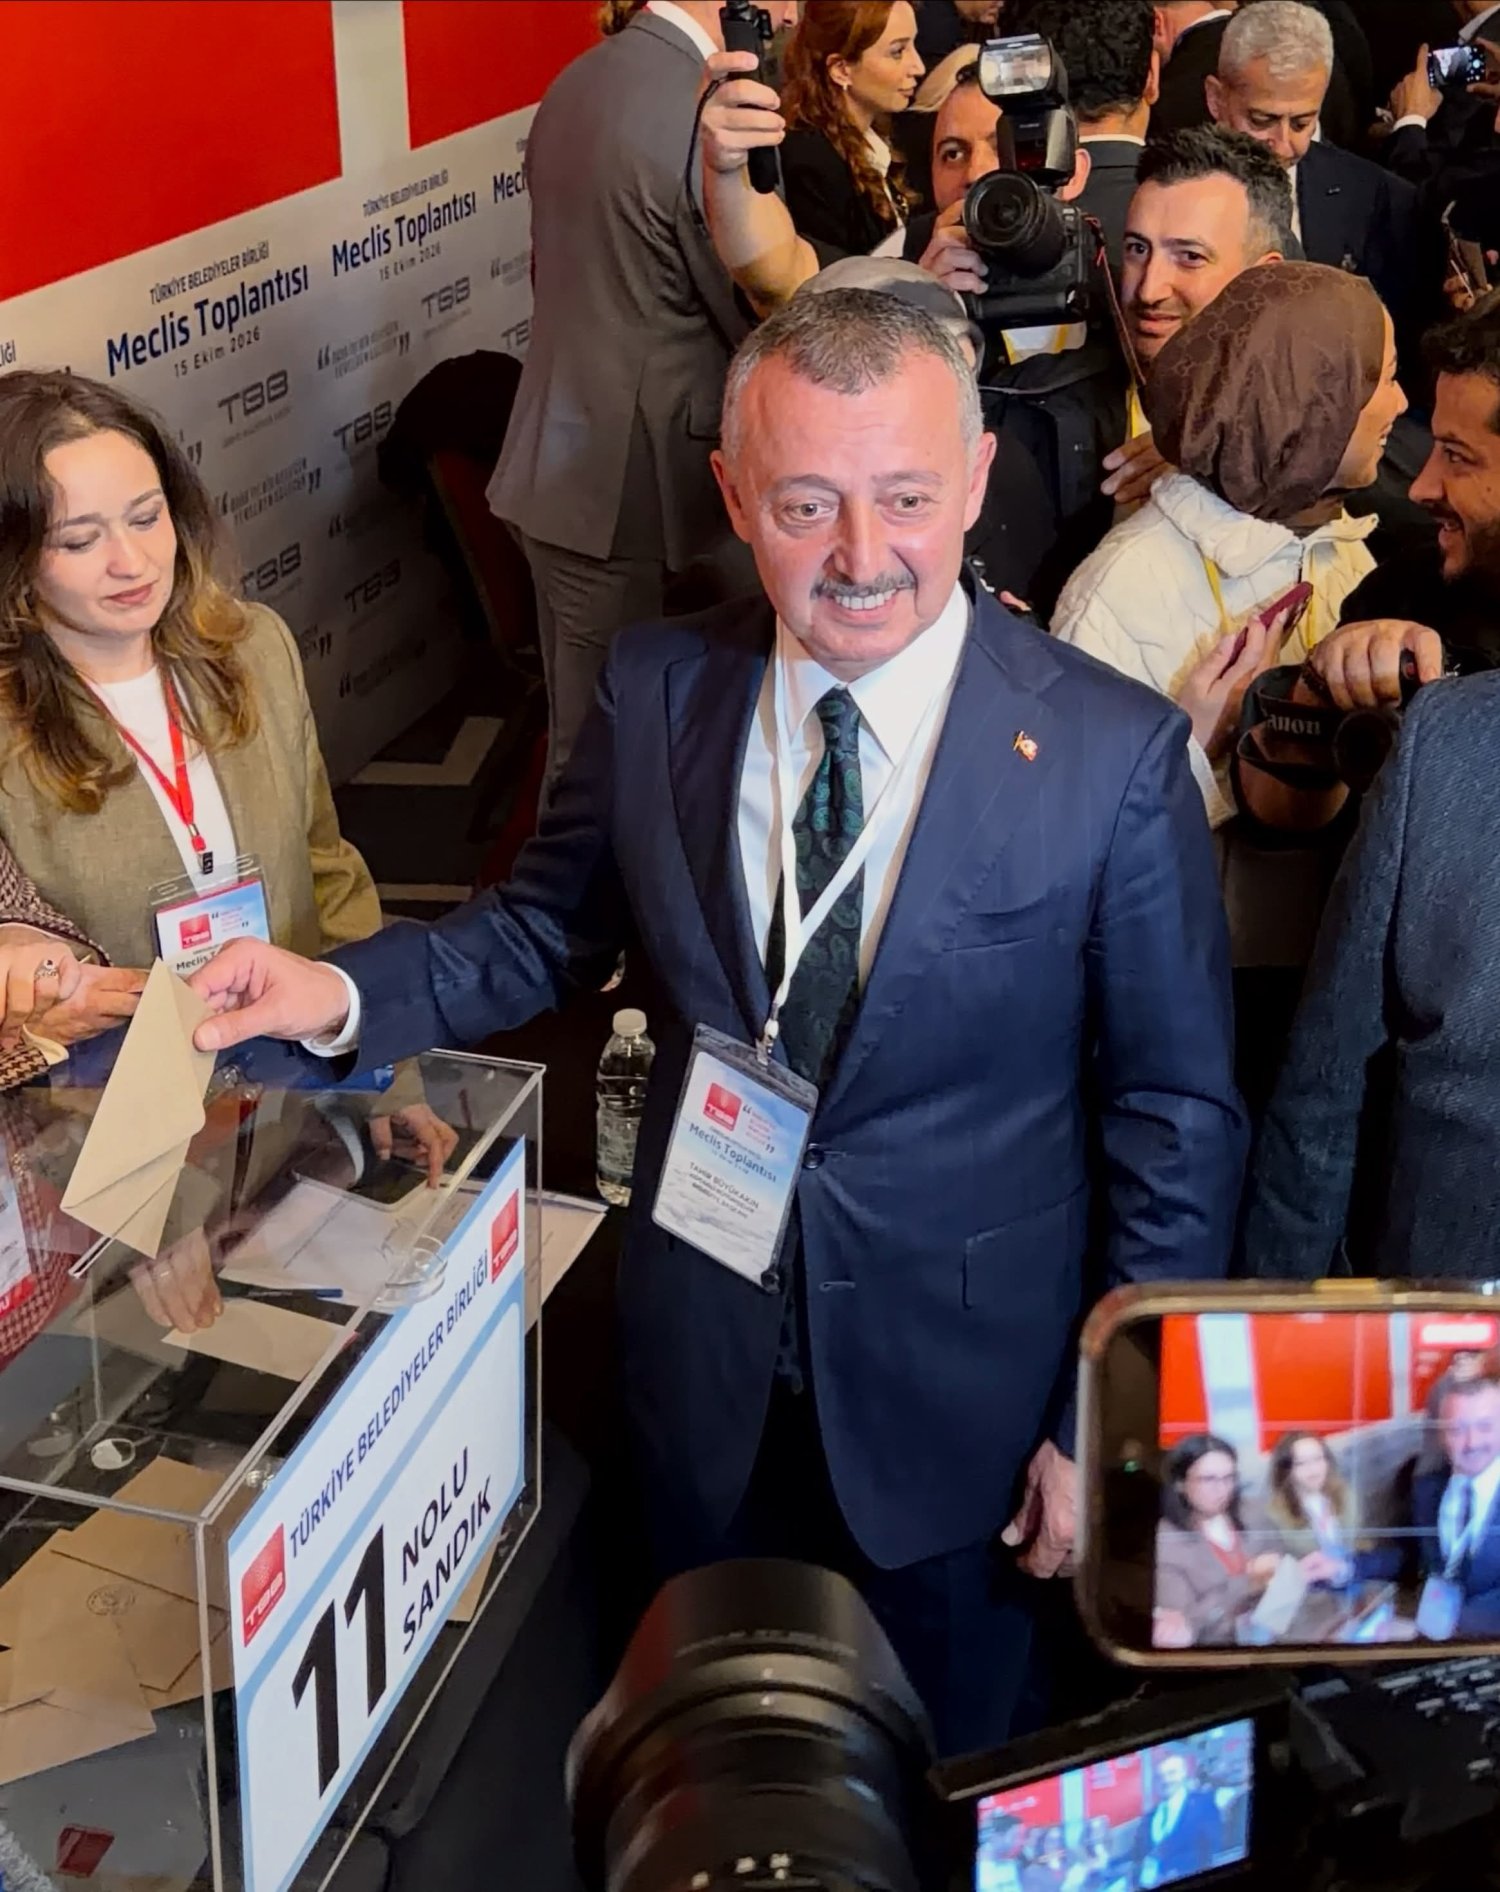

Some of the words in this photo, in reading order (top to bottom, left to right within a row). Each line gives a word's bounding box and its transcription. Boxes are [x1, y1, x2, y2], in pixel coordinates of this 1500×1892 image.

[332, 224, 391, 277] Meclis
[395, 191, 477, 247] Toplantısı
[107, 311, 190, 376] Meclis
[194, 265, 309, 337] Toplantısı
[174, 361, 188, 377] 15
[194, 345, 225, 370] Ekim
[230, 326, 261, 352] 2026
[1267, 713, 1321, 736] anon
[176, 955, 208, 971] Meclis
[689, 1122, 721, 1150] Meclis
[724, 1143, 777, 1182] Toplantısı
[289, 1448, 354, 1559] TÜRKİYE
[358, 1320, 443, 1465] BELEDİYELER
[446, 1248, 488, 1336] BİRLİĞİ
[402, 1445, 468, 1585] NOLU
[402, 1475, 492, 1655] SANDIK
[291, 1523, 387, 1800] 11
